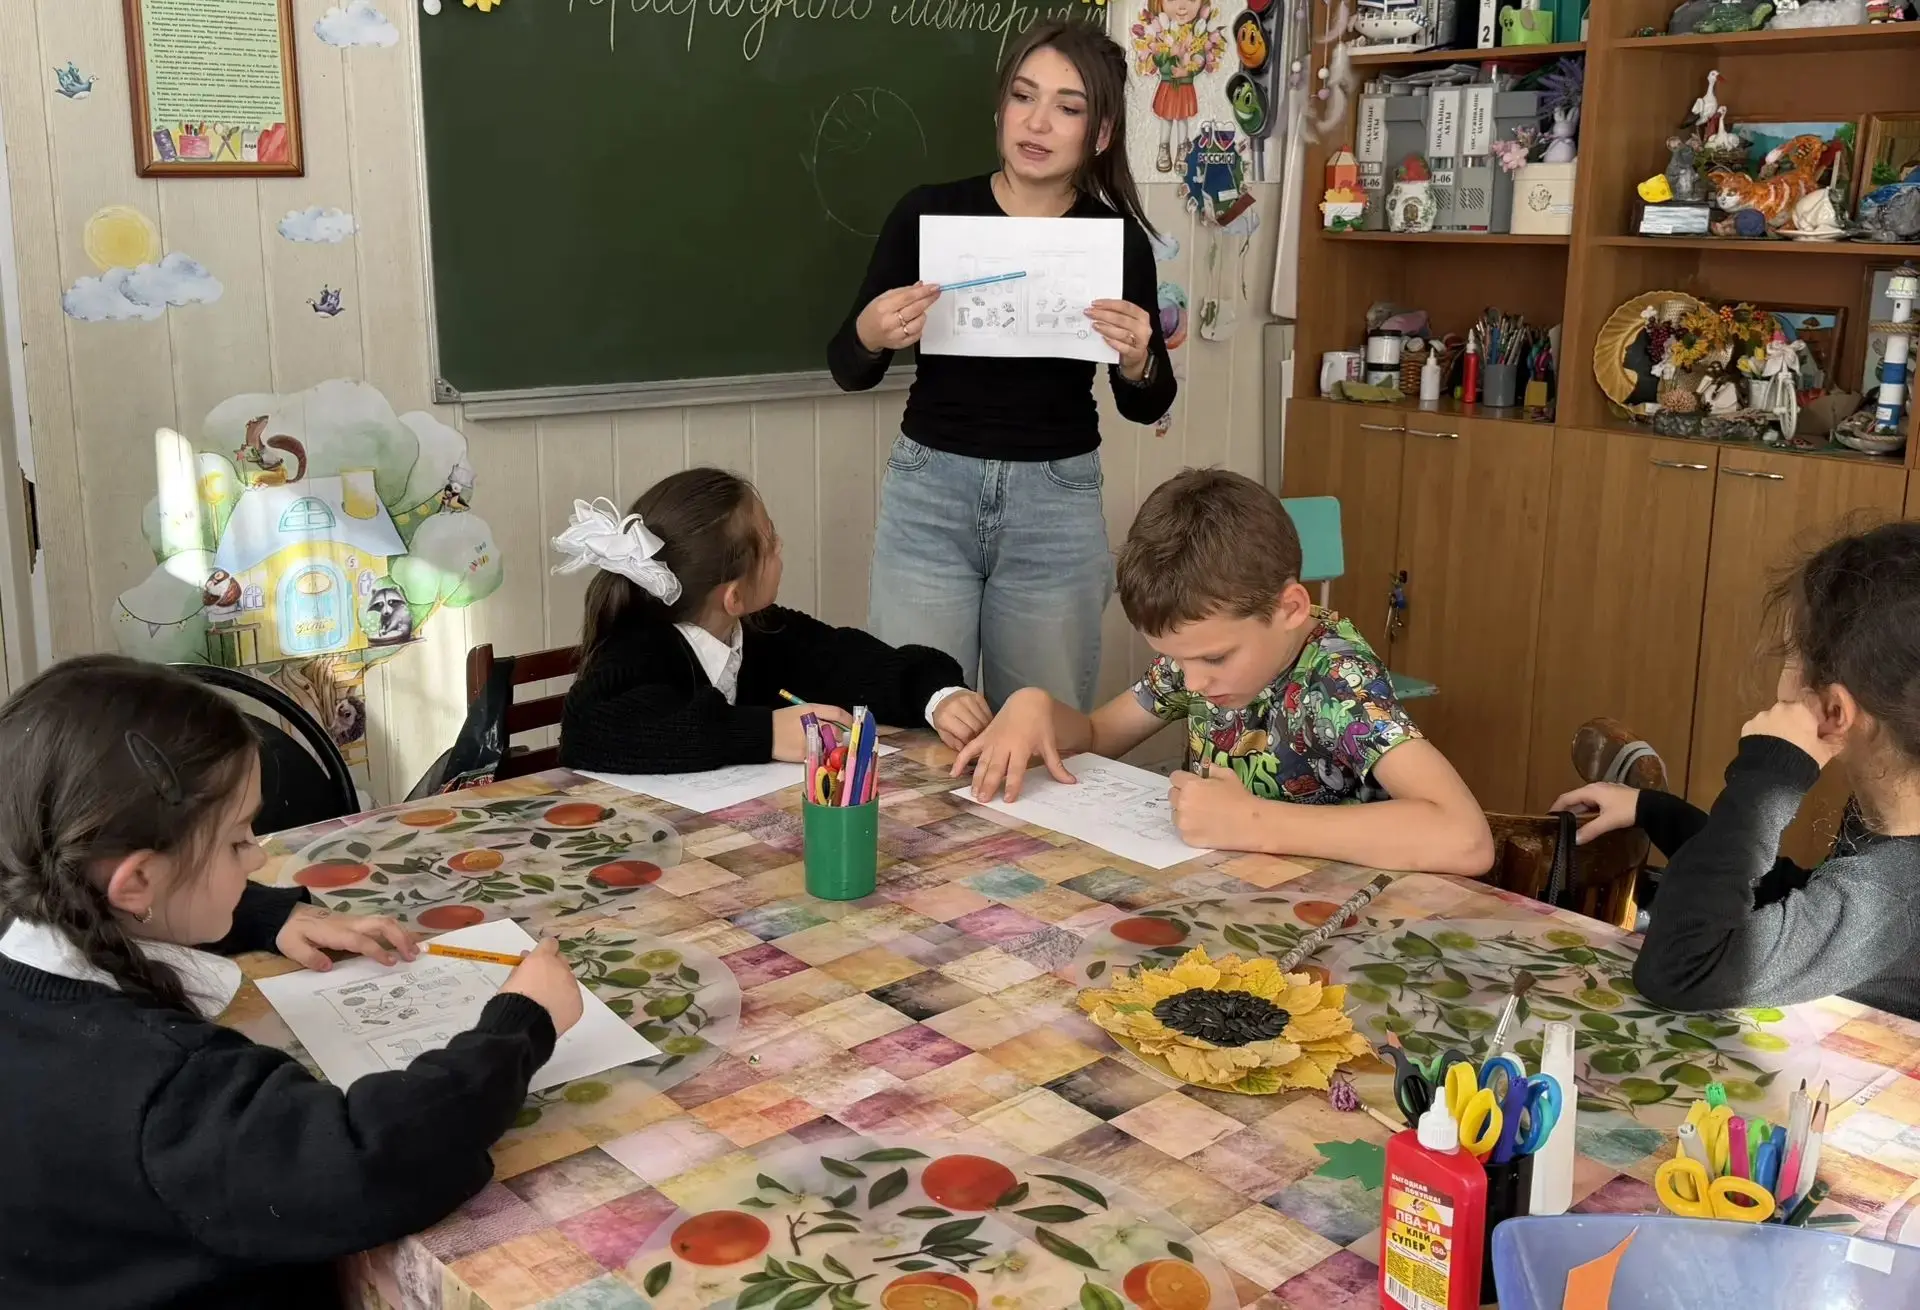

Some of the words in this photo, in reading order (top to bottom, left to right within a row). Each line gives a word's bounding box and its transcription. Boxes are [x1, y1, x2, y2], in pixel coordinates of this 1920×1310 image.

[1482, 25, 1491, 43] 2
[1373, 118, 1381, 141] АКТЫ
[1444, 111, 1452, 136] АКТЫ
[1391, 1173, 1428, 1192] ВЫГОДНАЯ
[1405, 1187, 1441, 1204] ПОКУПКА!
[1395, 1209, 1441, 1235] ПВА-М
[1391, 1232, 1426, 1252] СУПЕР
[1406, 1227, 1431, 1242] КЛЕЙ
